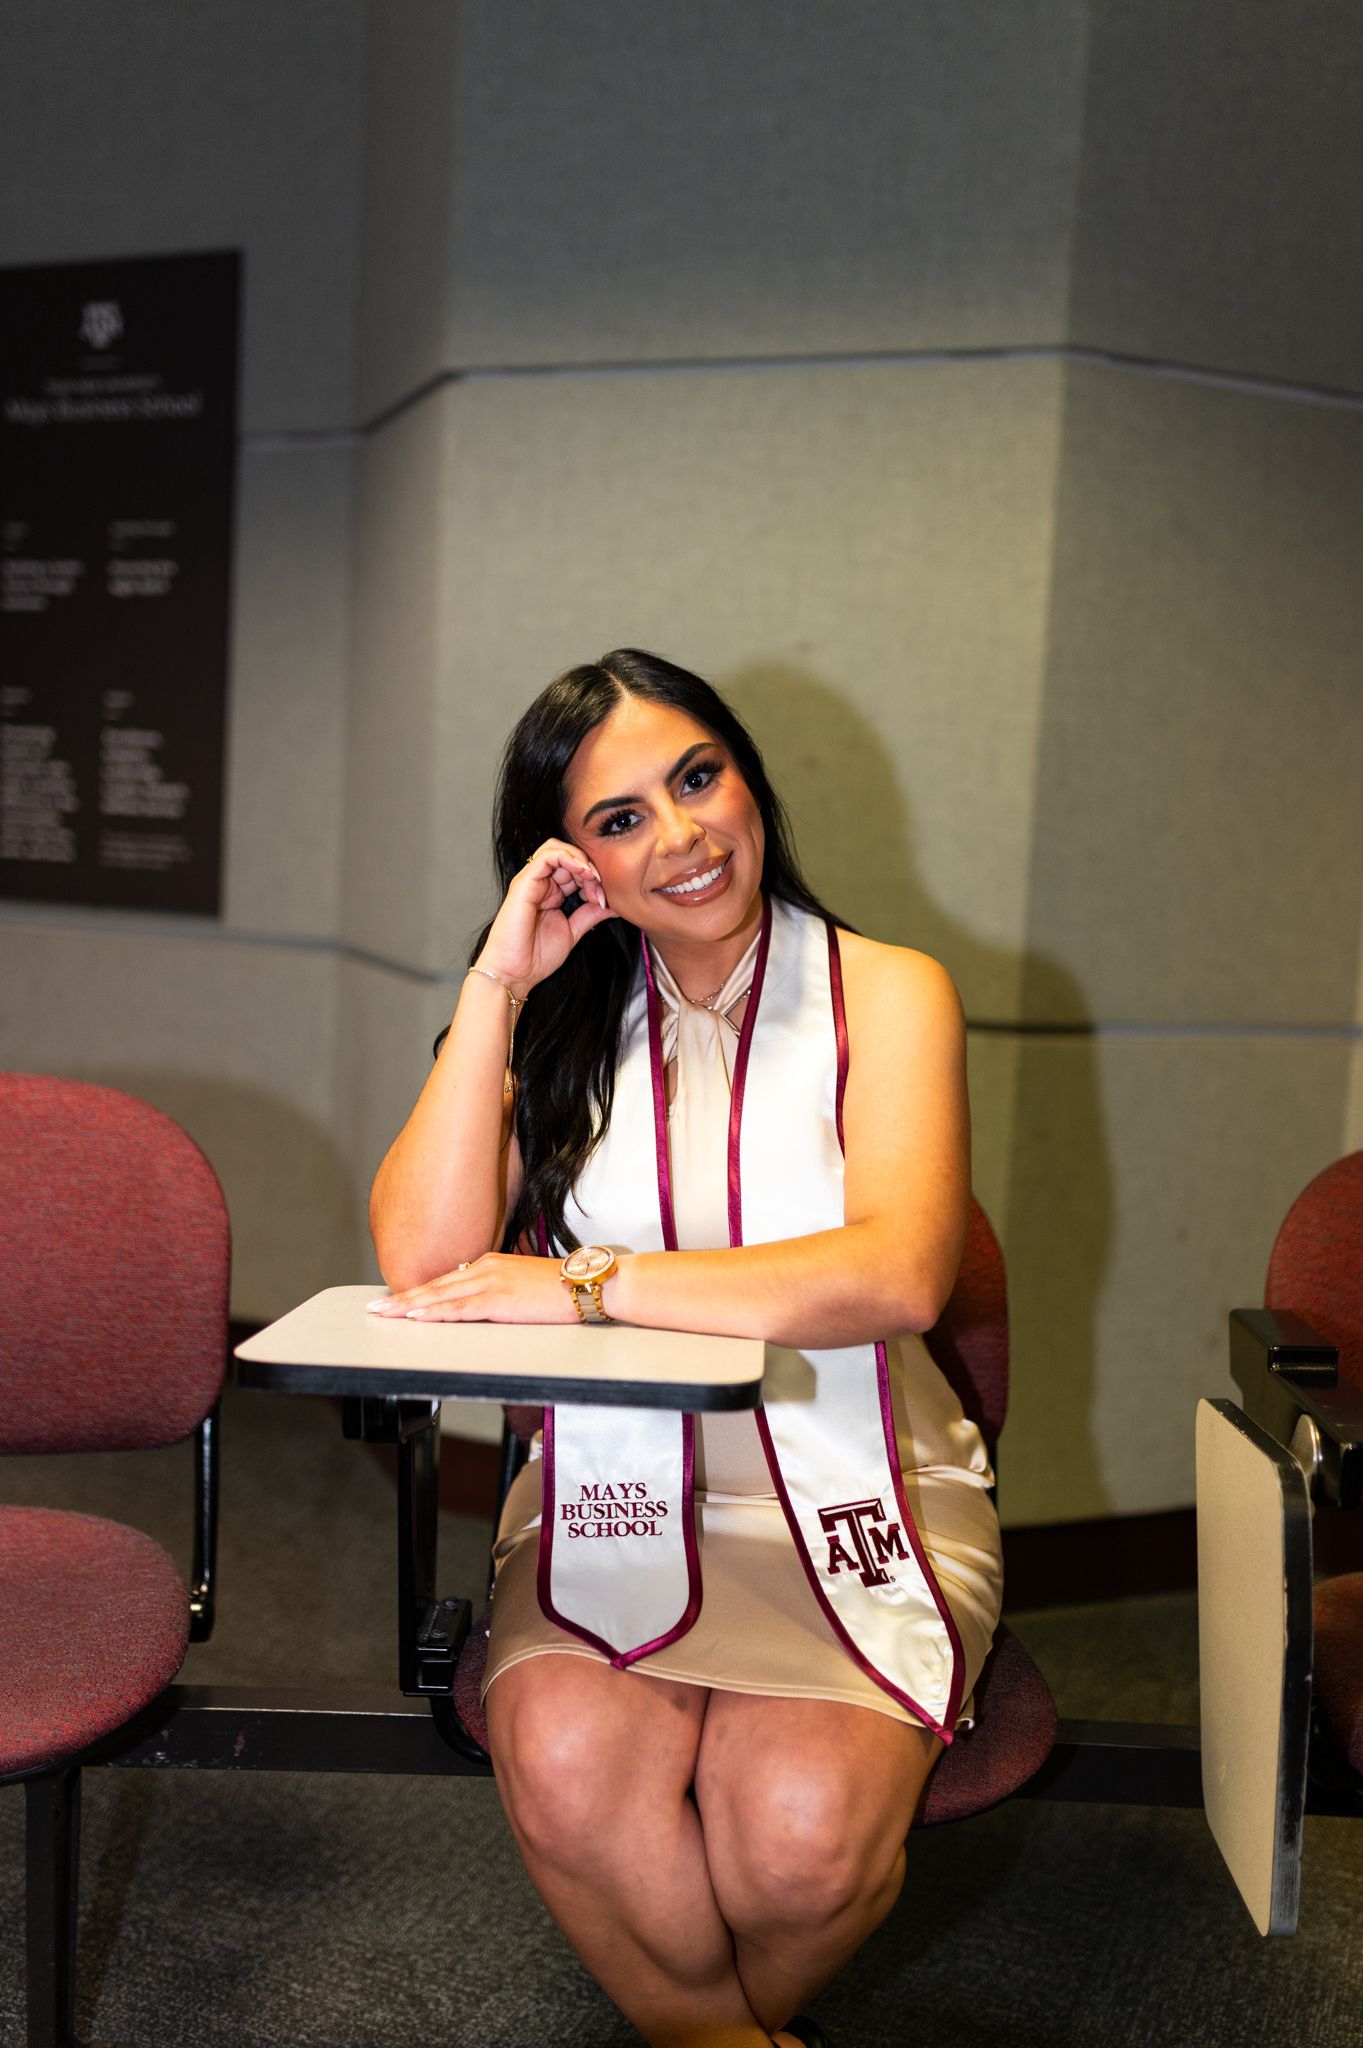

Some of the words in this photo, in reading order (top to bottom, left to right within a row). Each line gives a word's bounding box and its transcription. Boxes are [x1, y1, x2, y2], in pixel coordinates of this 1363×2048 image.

[579, 1482, 647, 1501] MAYS
[560, 1500, 668, 1520] BUSINESS
[567, 1520, 663, 1538] SCHOOL
